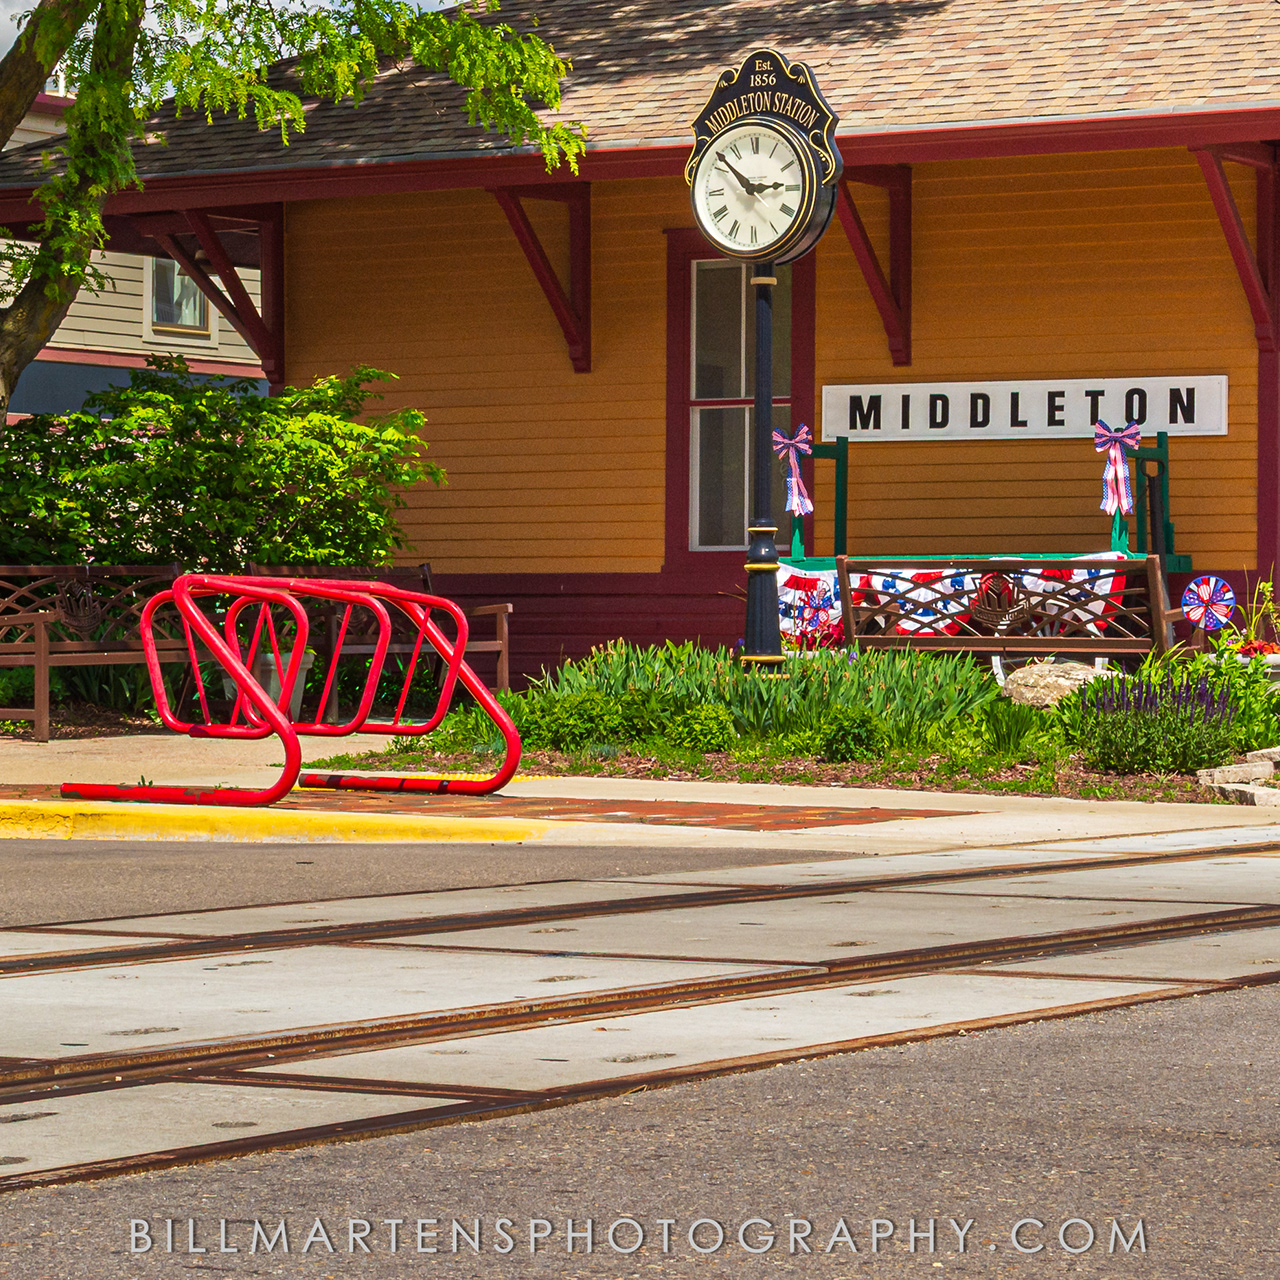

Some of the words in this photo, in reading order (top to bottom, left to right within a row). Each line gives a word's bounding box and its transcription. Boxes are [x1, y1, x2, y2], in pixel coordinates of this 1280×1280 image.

[750, 73, 776, 87] 1856
[755, 60, 773, 71] Est.
[705, 91, 772, 135] MIDDLETON
[773, 91, 820, 129] STATION
[849, 386, 1197, 431] MIDDLETON
